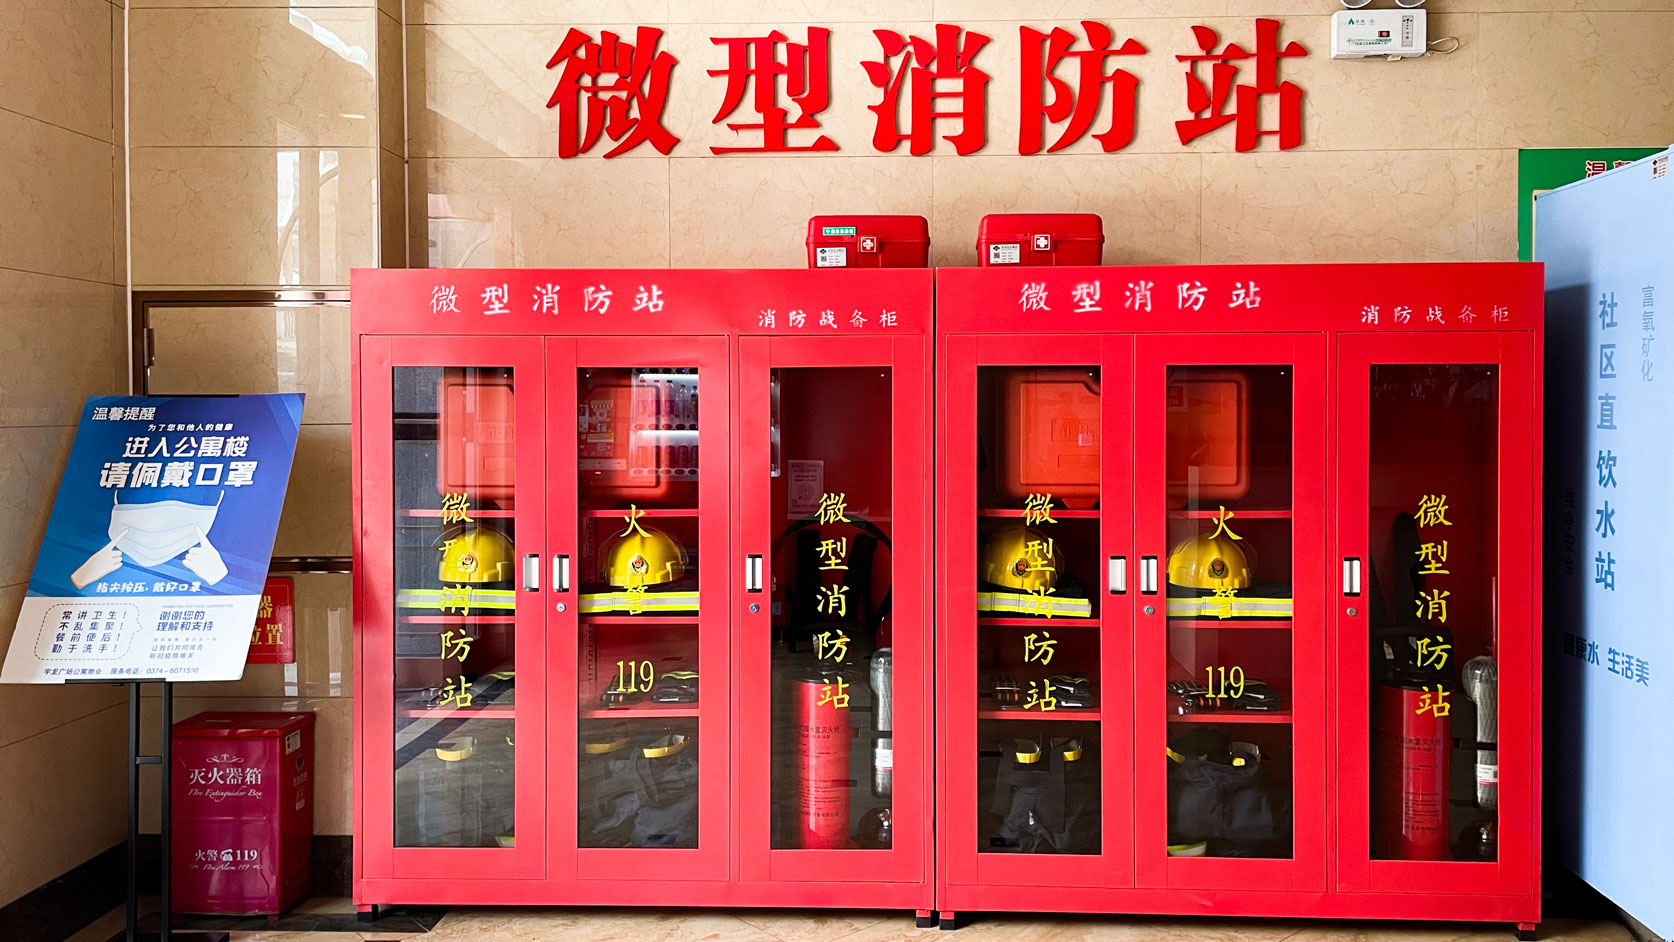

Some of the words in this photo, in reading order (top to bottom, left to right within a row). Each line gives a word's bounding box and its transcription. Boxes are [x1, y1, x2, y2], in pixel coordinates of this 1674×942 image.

[545, 18, 1309, 159] 微型消防站
[1585, 160, 1633, 179] 温
[429, 283, 666, 315] 微型消防站
[1018, 280, 1263, 313] 微型消防站
[757, 308, 900, 330] 消防战备柜
[1360, 305, 1512, 325] 消防战备柜
[1641, 284, 1656, 383] 富氧矿化
[92, 407, 156, 421] 温馨提醒
[148, 423, 234, 432] 为了您和他人的健康
[122, 436, 250, 457] 进入公寓楼
[1594, 291, 1618, 592] 社区直饮水站
[99, 461, 258, 488] 请佩戴口罩
[814, 492, 851, 709] 微型消防站
[1021, 492, 1058, 712] 微型消防站
[1414, 494, 1453, 718] 微型消防站
[156, 621, 214, 631] 理解和支持
[160, 610, 205, 621] 谢谢您的
[616, 660, 655, 693] 119
[1607, 646, 1651, 688] 生活美
[1205, 665, 1245, 699] 119
[188, 767, 262, 785] 灭火器箱
[195, 849, 218, 861] 火警
[236, 849, 258, 861] 119
